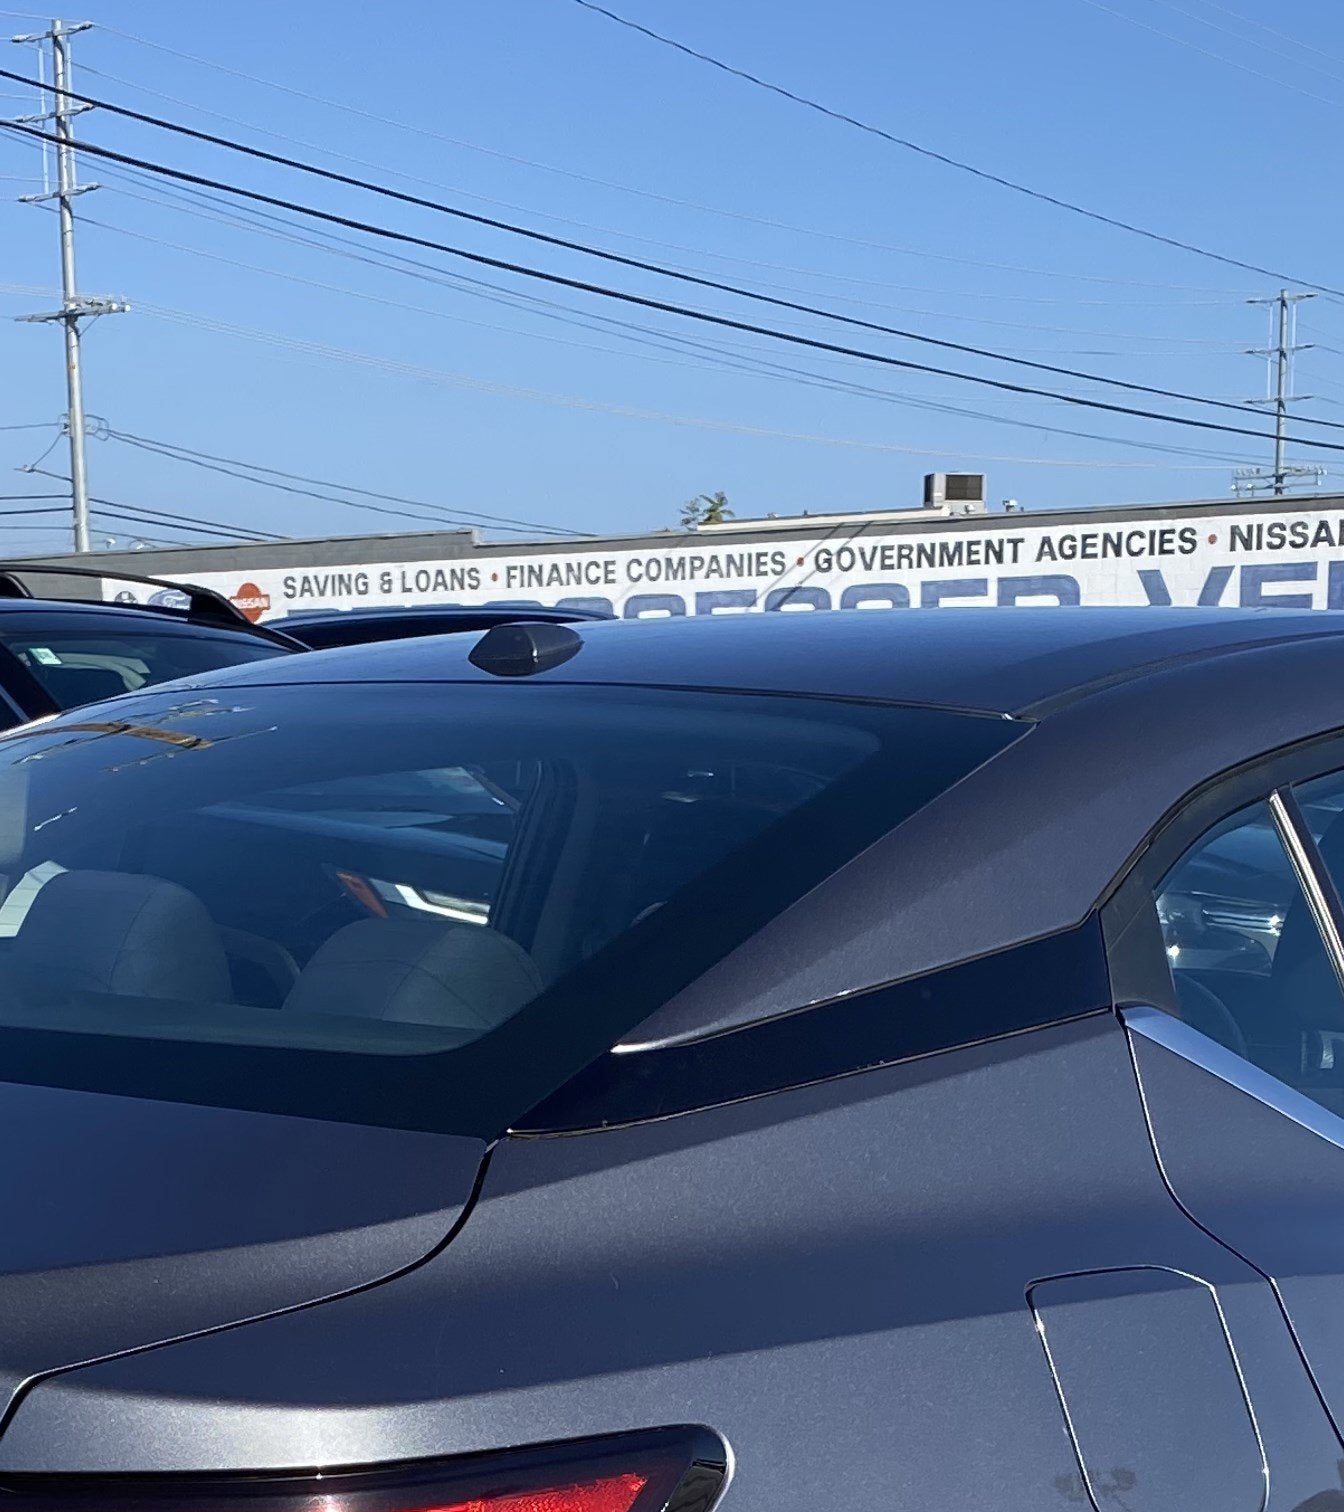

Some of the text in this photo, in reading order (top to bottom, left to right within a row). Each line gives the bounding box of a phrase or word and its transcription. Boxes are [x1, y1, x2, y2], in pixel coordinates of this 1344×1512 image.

[283, 572, 369, 600] SAVING
[380, 571, 394, 594] &
[401, 567, 481, 594] LOANS
[506, 559, 617, 589] FINANCE
[626, 551, 786, 583] COMPANIES
[814, 538, 1025, 573] GOVERNMENT
[1036, 527, 1198, 562] AGENCIES
